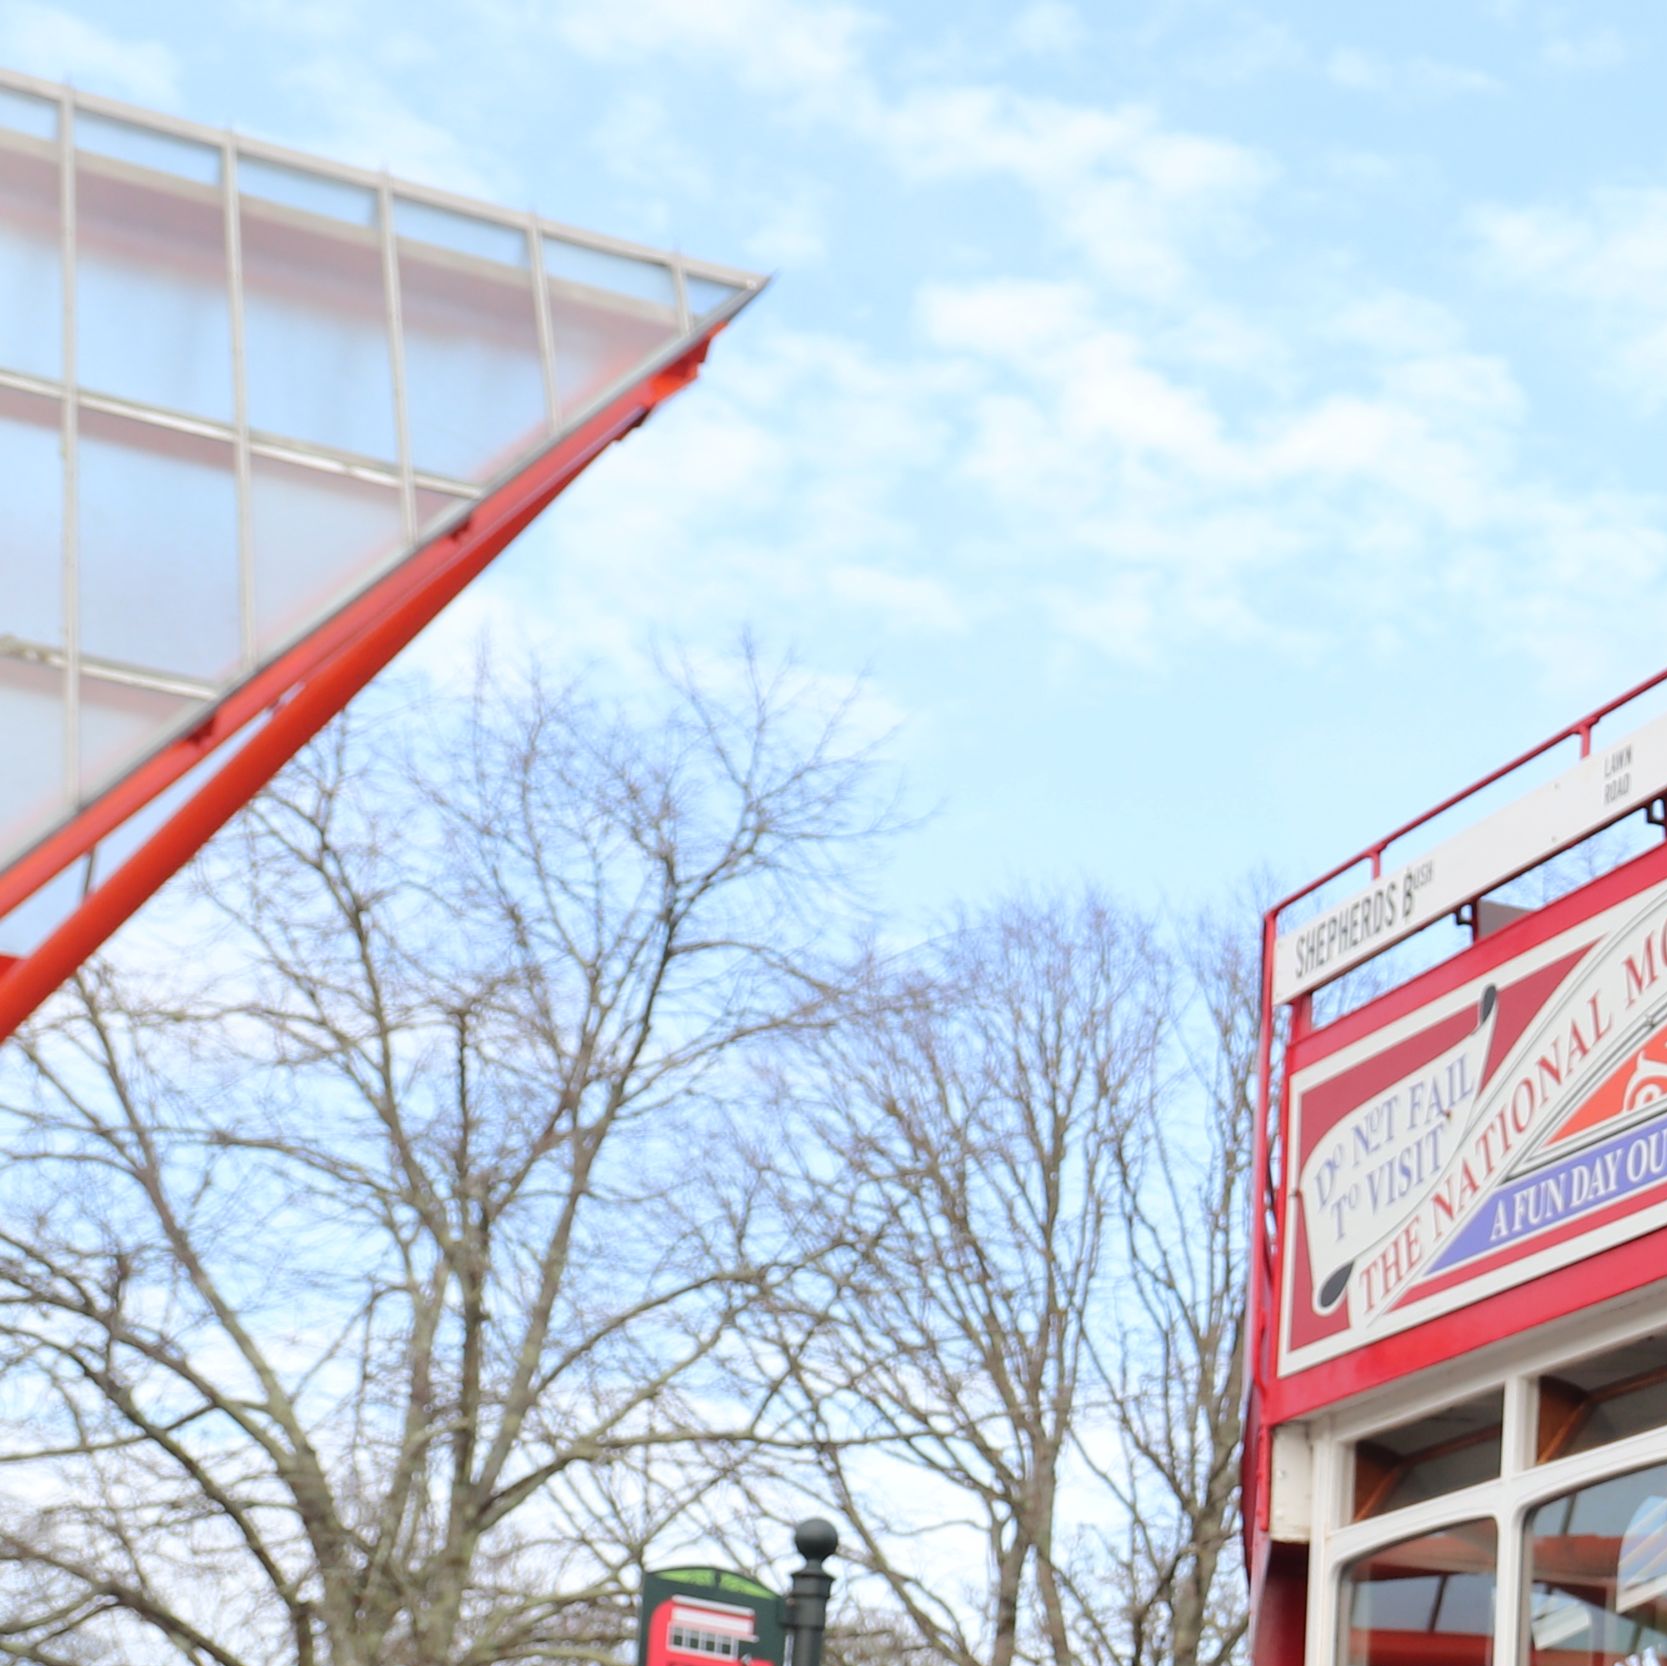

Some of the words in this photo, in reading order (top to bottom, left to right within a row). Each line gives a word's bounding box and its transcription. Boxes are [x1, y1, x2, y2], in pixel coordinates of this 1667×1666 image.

[1295, 881, 1397, 979] SHEPHERDS
[1402, 859, 1434, 920] BUSH
[1313, 1143, 1345, 1211] DO
[1350, 1093, 1400, 1169] NOT
[1405, 1052, 1476, 1131] FAIL
[1330, 1182, 1360, 1243] TO
[1364, 1121, 1446, 1217] VISIT
[1359, 1214, 1423, 1315] THE
[1431, 994, 1617, 1240] NATIONAL
[1490, 1205, 1512, 1242] A
[1513, 1171, 1574, 1232] FUN
[1571, 1145, 1627, 1207] DAY
